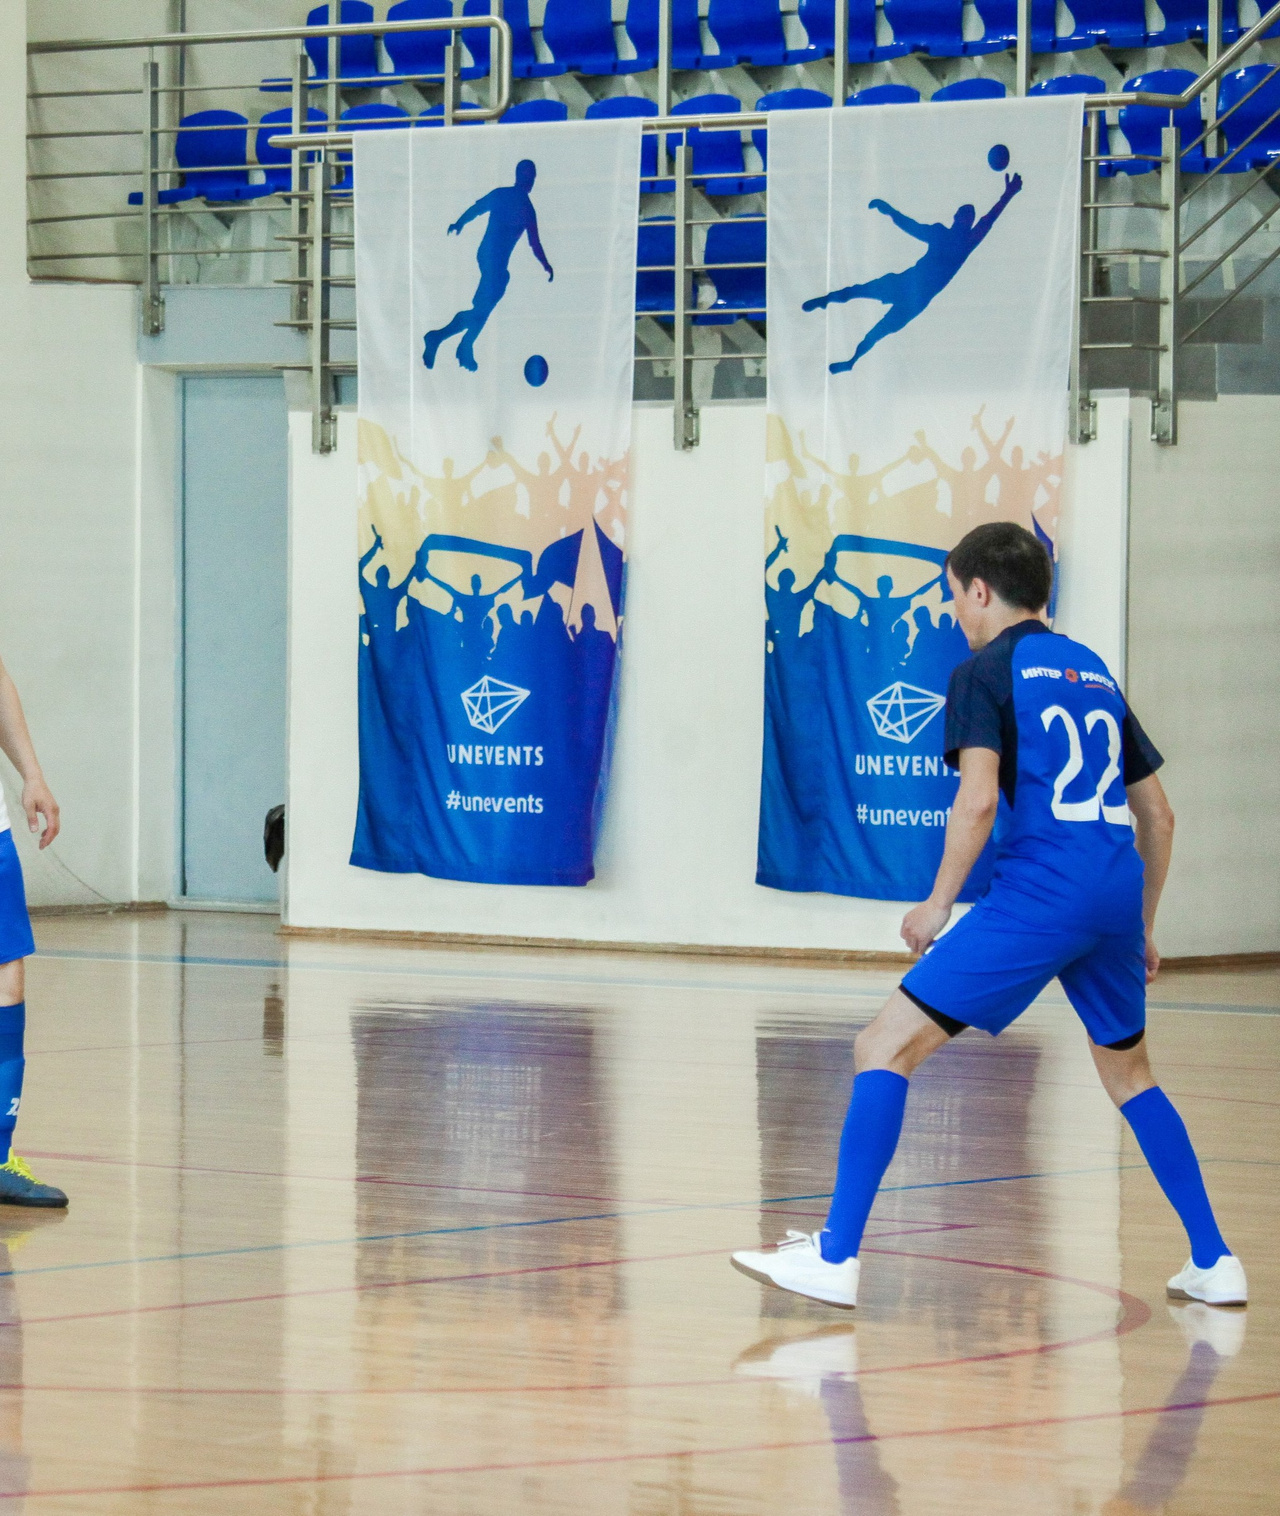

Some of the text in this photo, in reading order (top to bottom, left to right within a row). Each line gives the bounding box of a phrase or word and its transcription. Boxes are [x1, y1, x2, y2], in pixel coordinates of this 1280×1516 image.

[1021, 666, 1062, 679] ИНТЕР
[446, 743, 544, 767] UNEVENTS
[855, 754, 961, 777] UNEVENT
[1040, 705, 1132, 827] 22
[445, 789, 544, 814] #unevents
[856, 803, 954, 827] #unevent
